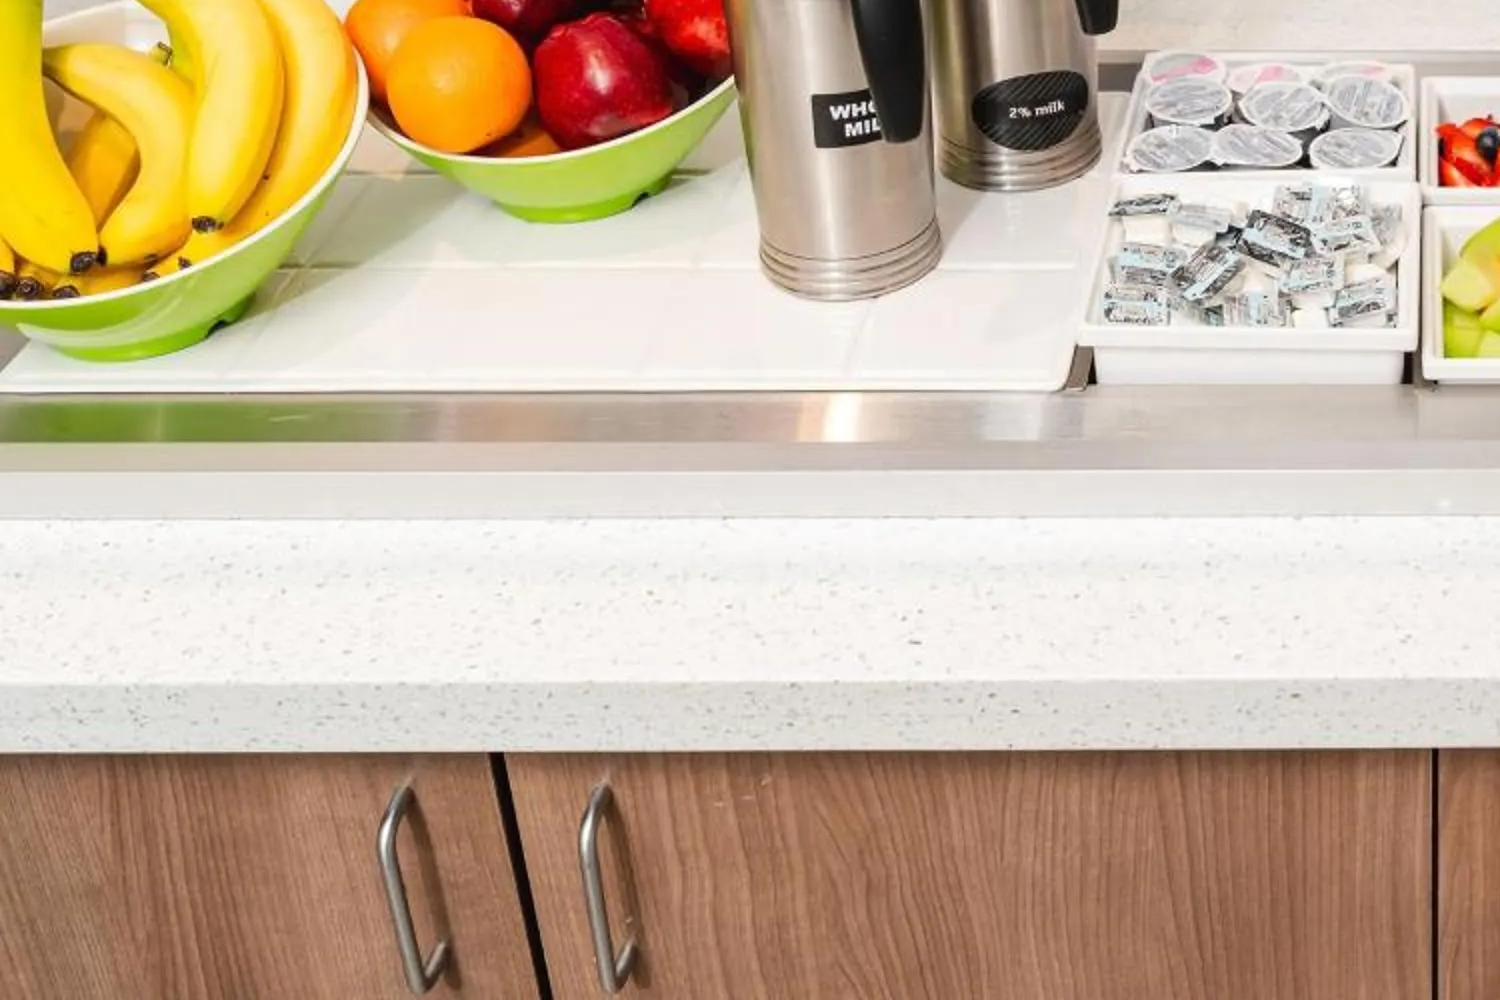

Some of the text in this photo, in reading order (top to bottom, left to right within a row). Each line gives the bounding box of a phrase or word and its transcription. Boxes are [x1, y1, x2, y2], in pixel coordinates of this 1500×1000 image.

[1008, 100, 1065, 119] 2% milk
[844, 117, 881, 137] MIL
